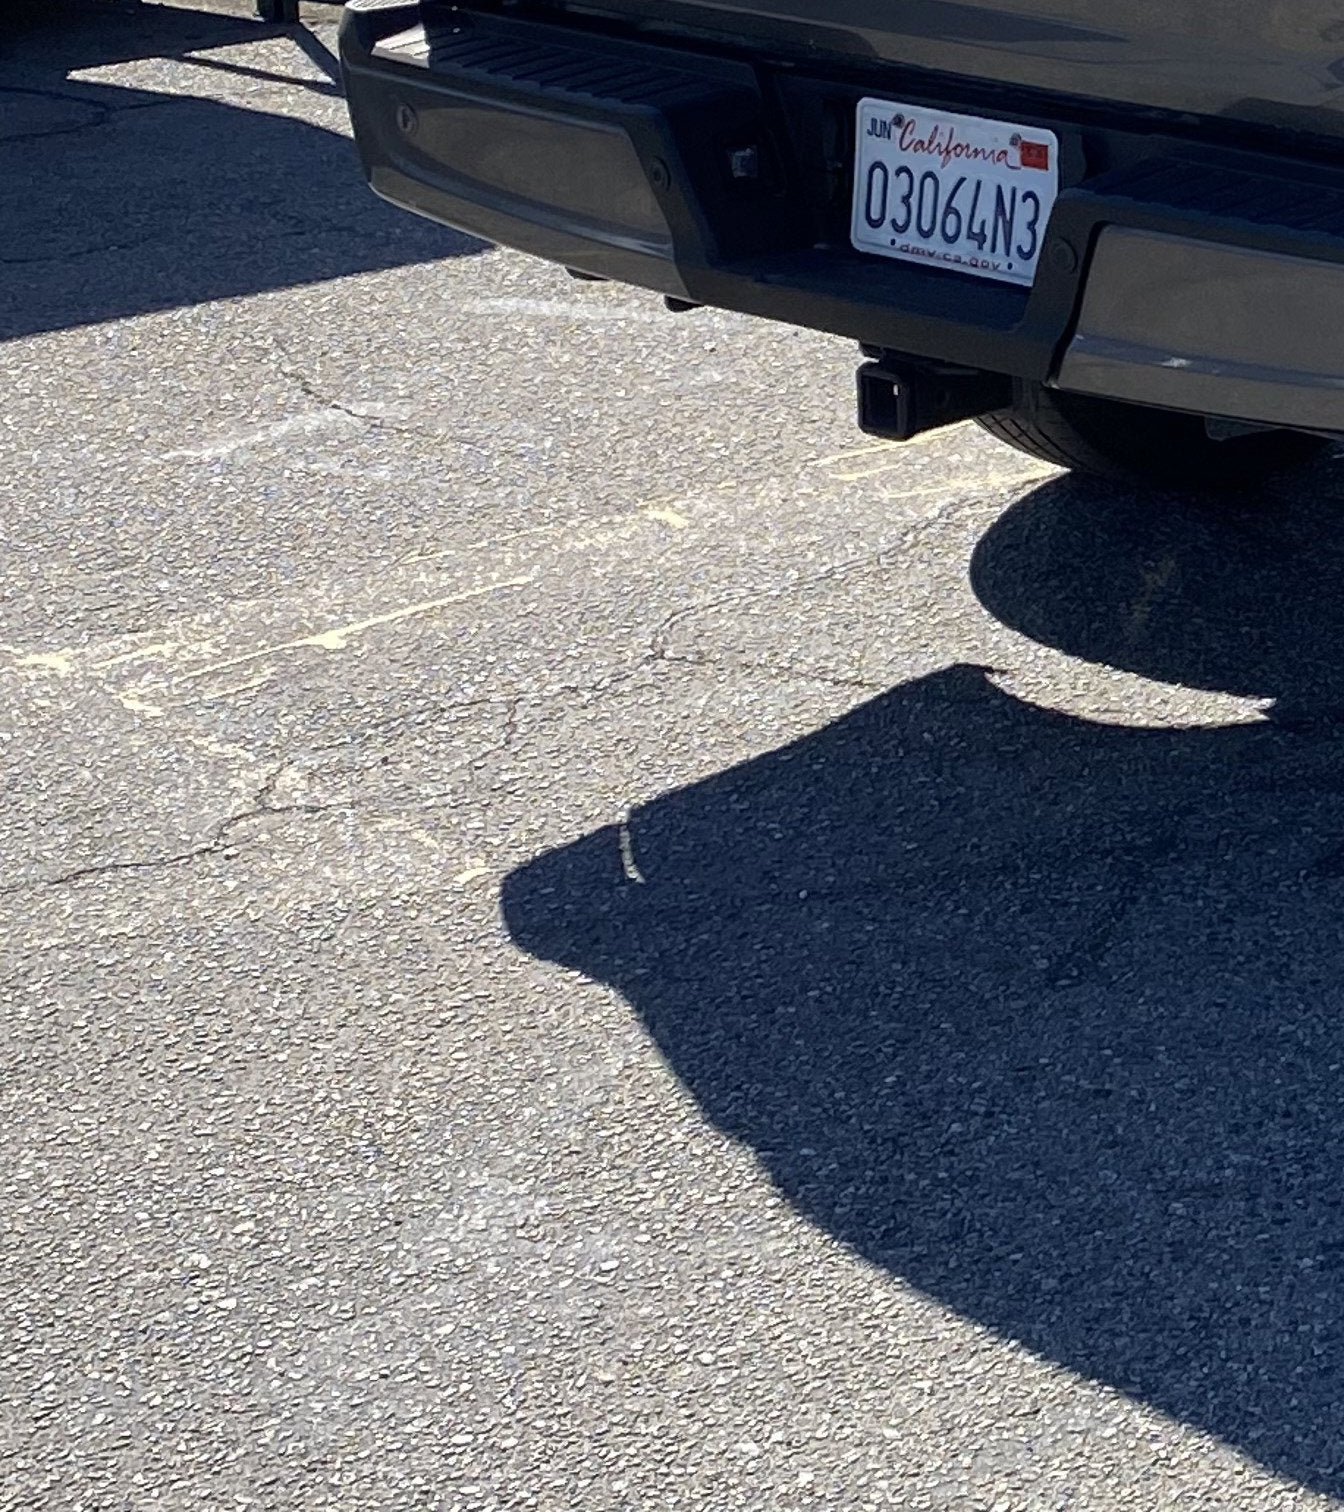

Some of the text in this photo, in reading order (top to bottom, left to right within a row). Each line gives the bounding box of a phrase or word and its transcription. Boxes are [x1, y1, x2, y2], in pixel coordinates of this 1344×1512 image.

[866, 117, 892, 140] JUN
[898, 119, 1022, 169] California
[864, 160, 1041, 261] 03064N3
[900, 243, 1001, 271] dmv.ca.gov
